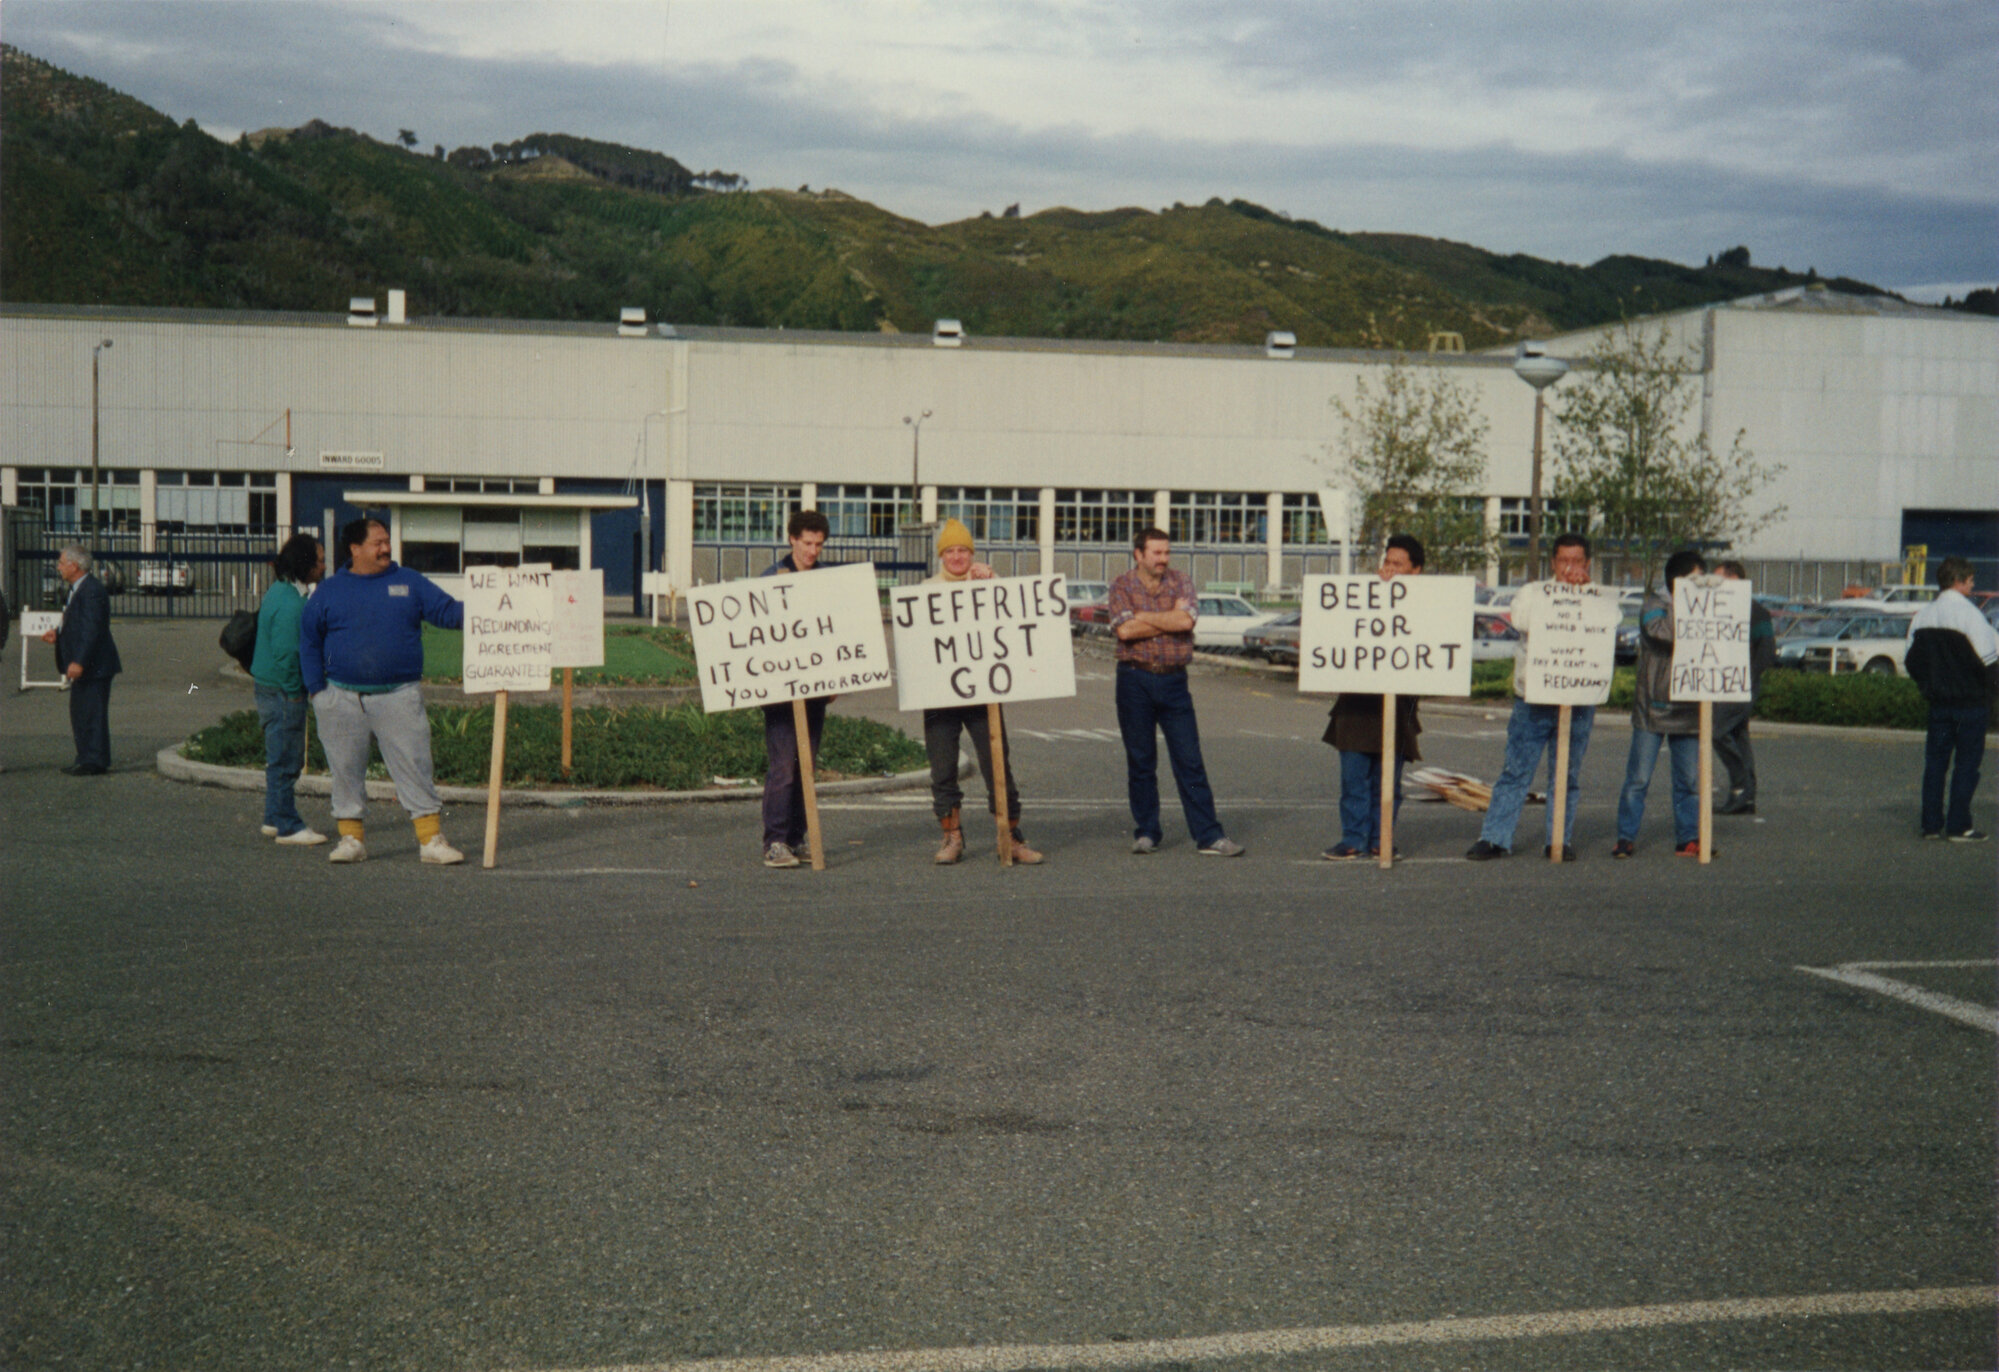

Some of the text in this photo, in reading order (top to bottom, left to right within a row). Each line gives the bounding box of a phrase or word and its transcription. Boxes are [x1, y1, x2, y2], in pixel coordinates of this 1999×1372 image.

[322, 455, 382, 465] INWARD GOODS
[470, 572, 552, 589] WE WANT
[498, 592, 513, 611] A
[896, 577, 1068, 629] JEFFRIES
[1320, 581, 1408, 610] BEEP
[1683, 587, 1736, 620] WE
[31, 623, 57, 631] ENTR
[728, 615, 835, 649] LAUGH
[1355, 614, 1412, 639] FOR
[1676, 618, 1750, 643] DESERVE
[934, 623, 1038, 664] MUST
[1311, 643, 1462, 671] SUPPORT
[1700, 641, 1720, 665] A
[710, 643, 868, 685] IT COULD BE
[725, 669, 890, 708] YOU TOMORROW
[950, 662, 1013, 700] GO
[1708, 665, 1751, 694] DEAL
